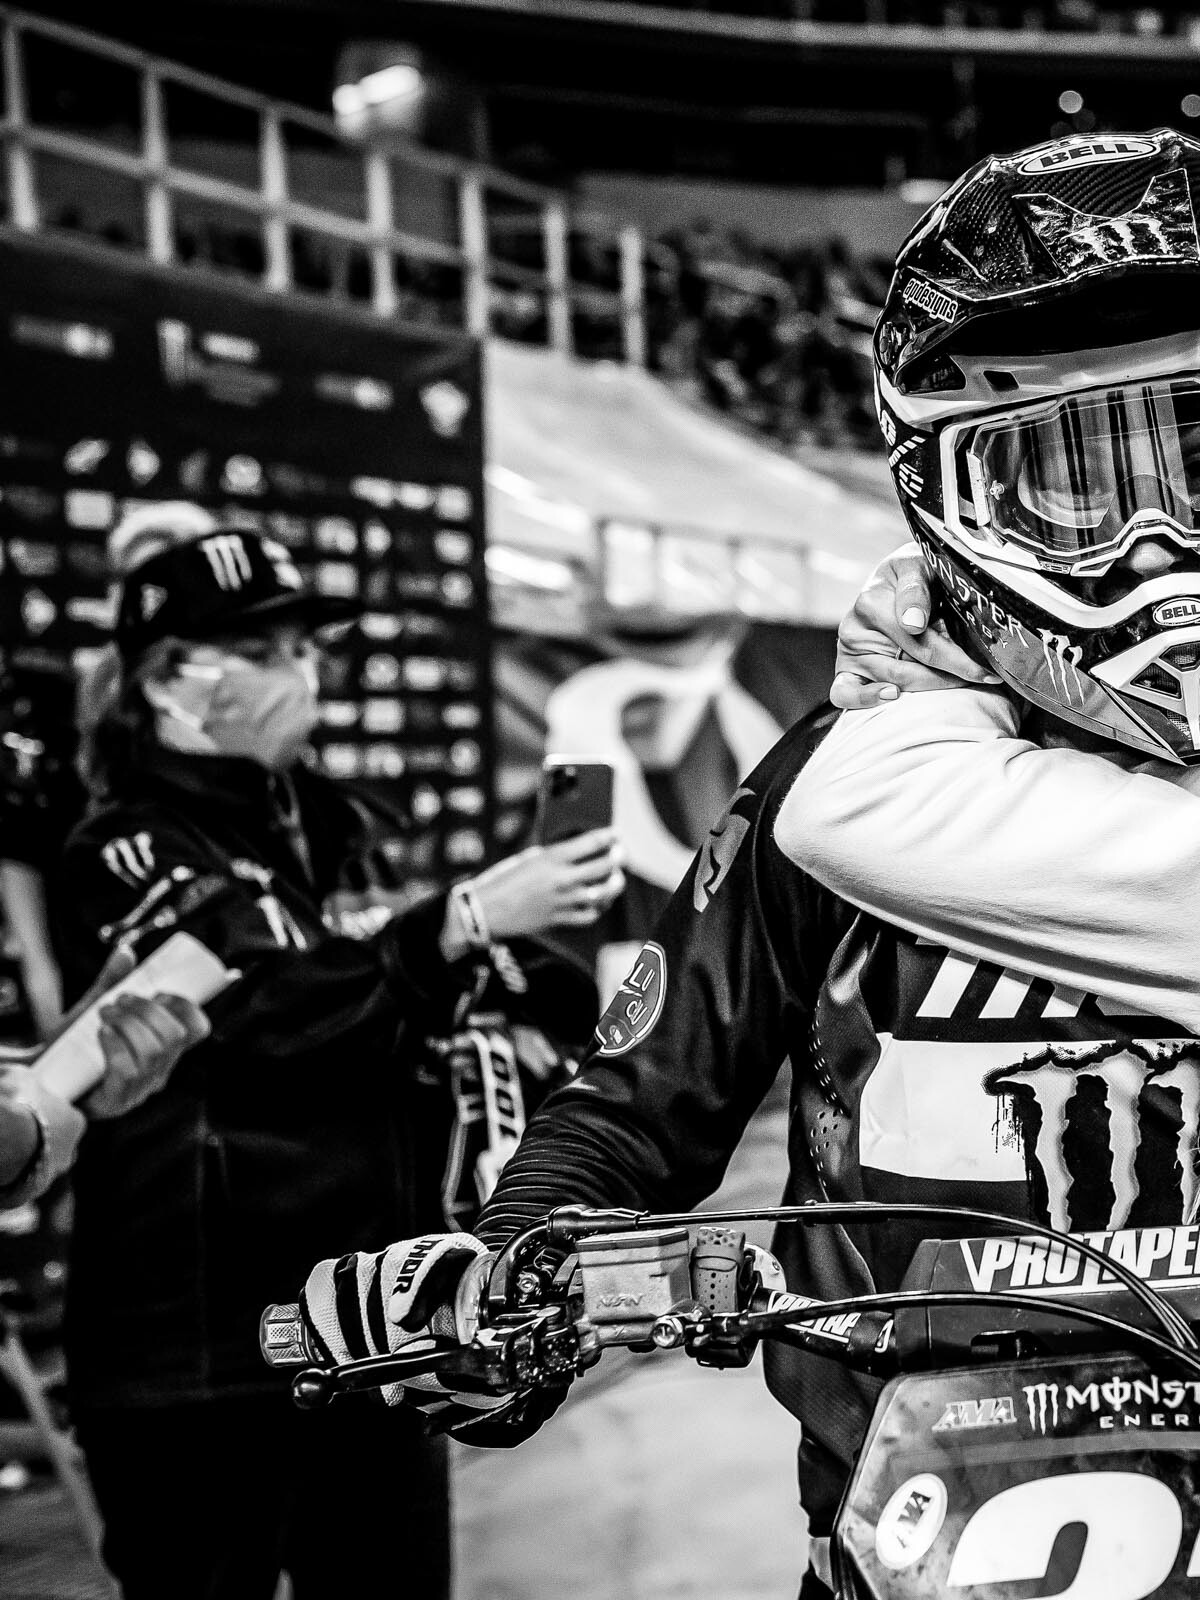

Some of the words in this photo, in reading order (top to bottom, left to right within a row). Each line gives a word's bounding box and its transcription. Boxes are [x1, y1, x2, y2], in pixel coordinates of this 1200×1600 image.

[1039, 143, 1139, 168] BELL
[903, 278, 958, 323] apdesigns
[914, 532, 1030, 649] ONSTER
[931, 1396, 1018, 1431] AMA
